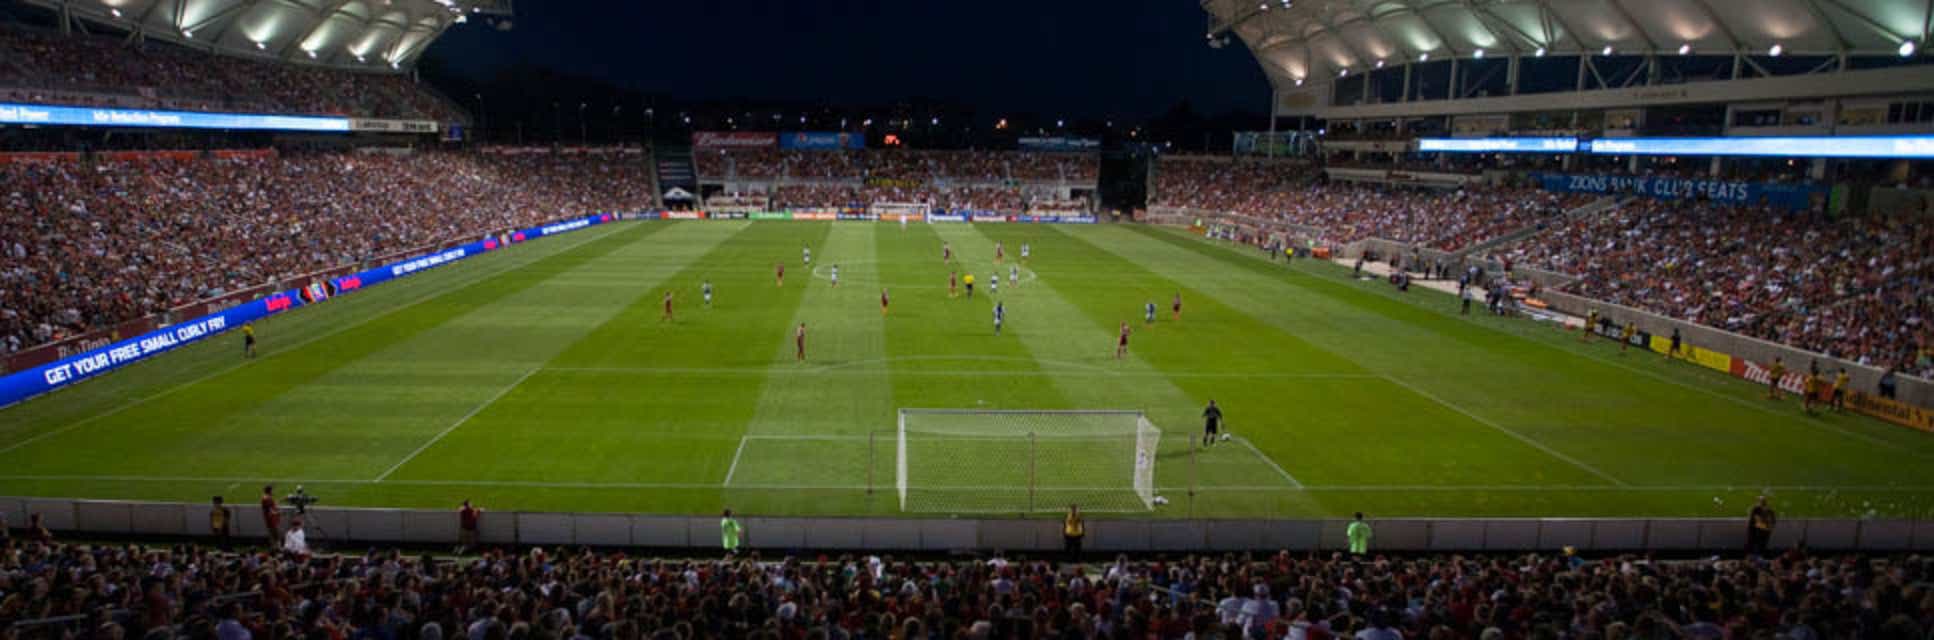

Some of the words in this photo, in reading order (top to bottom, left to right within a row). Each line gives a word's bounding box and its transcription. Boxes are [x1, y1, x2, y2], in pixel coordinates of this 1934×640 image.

[1568, 175, 1608, 191] ZIONS
[45, 364, 73, 385] GET
[73, 350, 110, 375] YOUR
[109, 343, 141, 364] FREE
[140, 331, 179, 353] SMALL
[177, 320, 209, 341] CURLY
[207, 315, 226, 332] FRY
